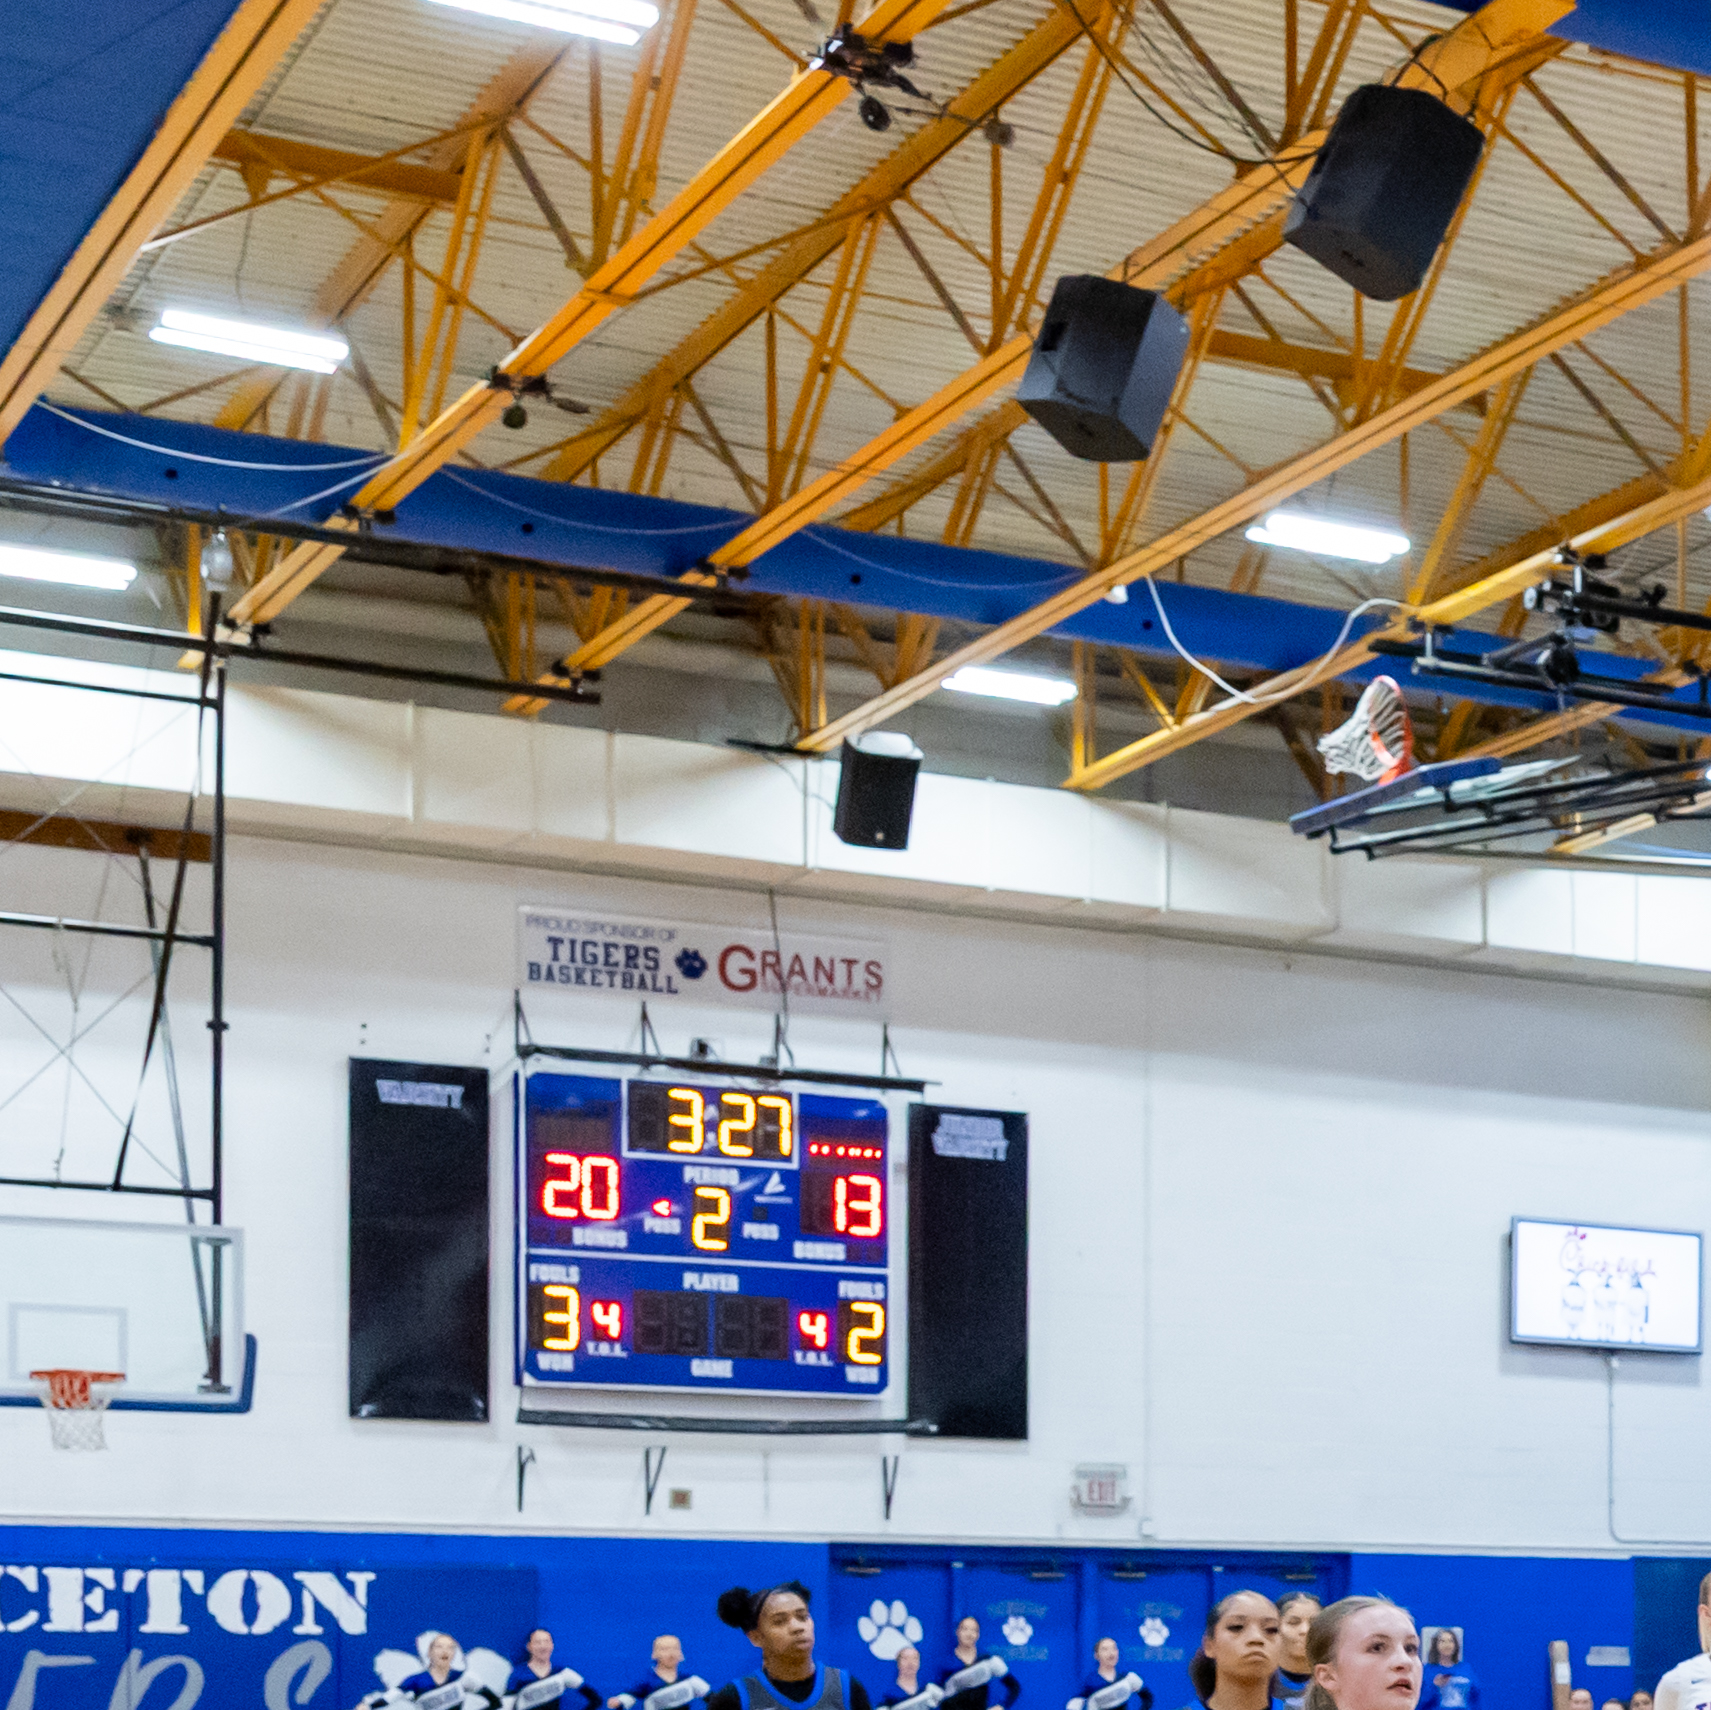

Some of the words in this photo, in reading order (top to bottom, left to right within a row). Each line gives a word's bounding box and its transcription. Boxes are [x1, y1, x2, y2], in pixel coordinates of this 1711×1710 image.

[528, 961, 678, 994] BASKETBALL
[548, 936, 660, 971] TIGERS
[718, 944, 883, 992] GRANTS
[542, 1152, 620, 1220] 20
[833, 1174, 882, 1238] 13
[692, 1186, 732, 1251] 2
[683, 1271, 740, 1293] PLAYER
[543, 1284, 581, 1351] 3
[591, 1300, 623, 1340] 4
[798, 1312, 829, 1349] 4
[846, 1300, 886, 1365] 2
